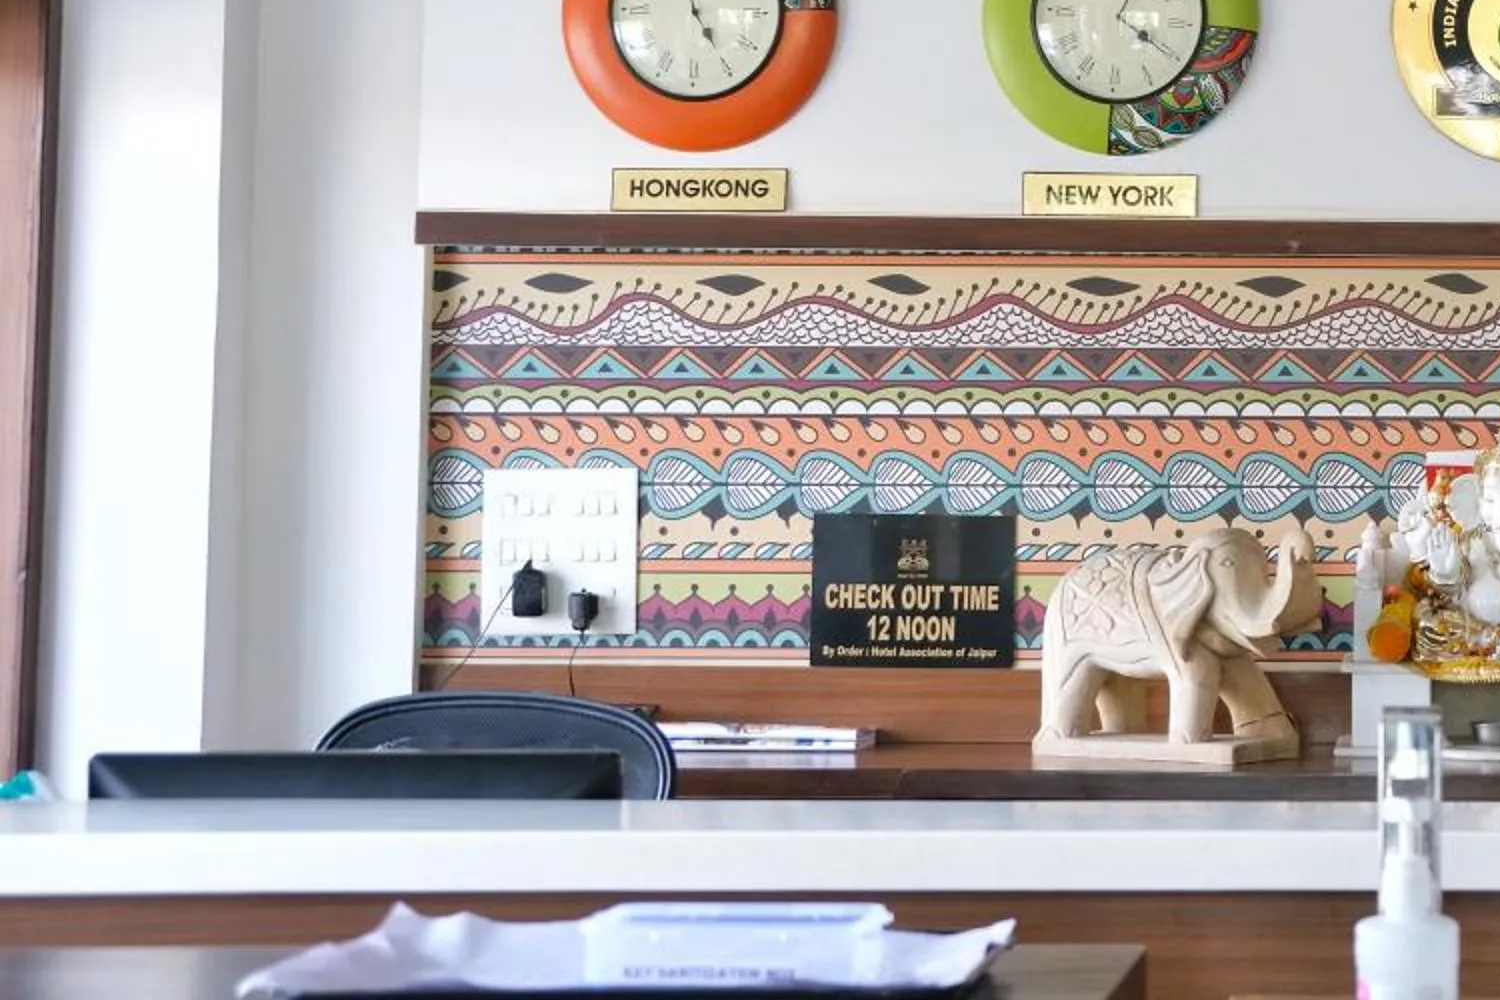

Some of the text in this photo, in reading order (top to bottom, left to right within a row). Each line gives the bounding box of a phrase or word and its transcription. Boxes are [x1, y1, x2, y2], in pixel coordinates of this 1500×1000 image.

[629, 178, 769, 199] HONGKONG
[1045, 183, 1175, 207] NEW YORK
[824, 583, 1000, 611] CHECK OUT TIME
[866, 615, 956, 641] 12 NOON
[822, 645, 834, 658] By
[871, 646, 897, 657] Hotel
[900, 647, 952, 658] Association
[956, 647, 965, 657] of
[967, 648, 997, 660] Jaipur
